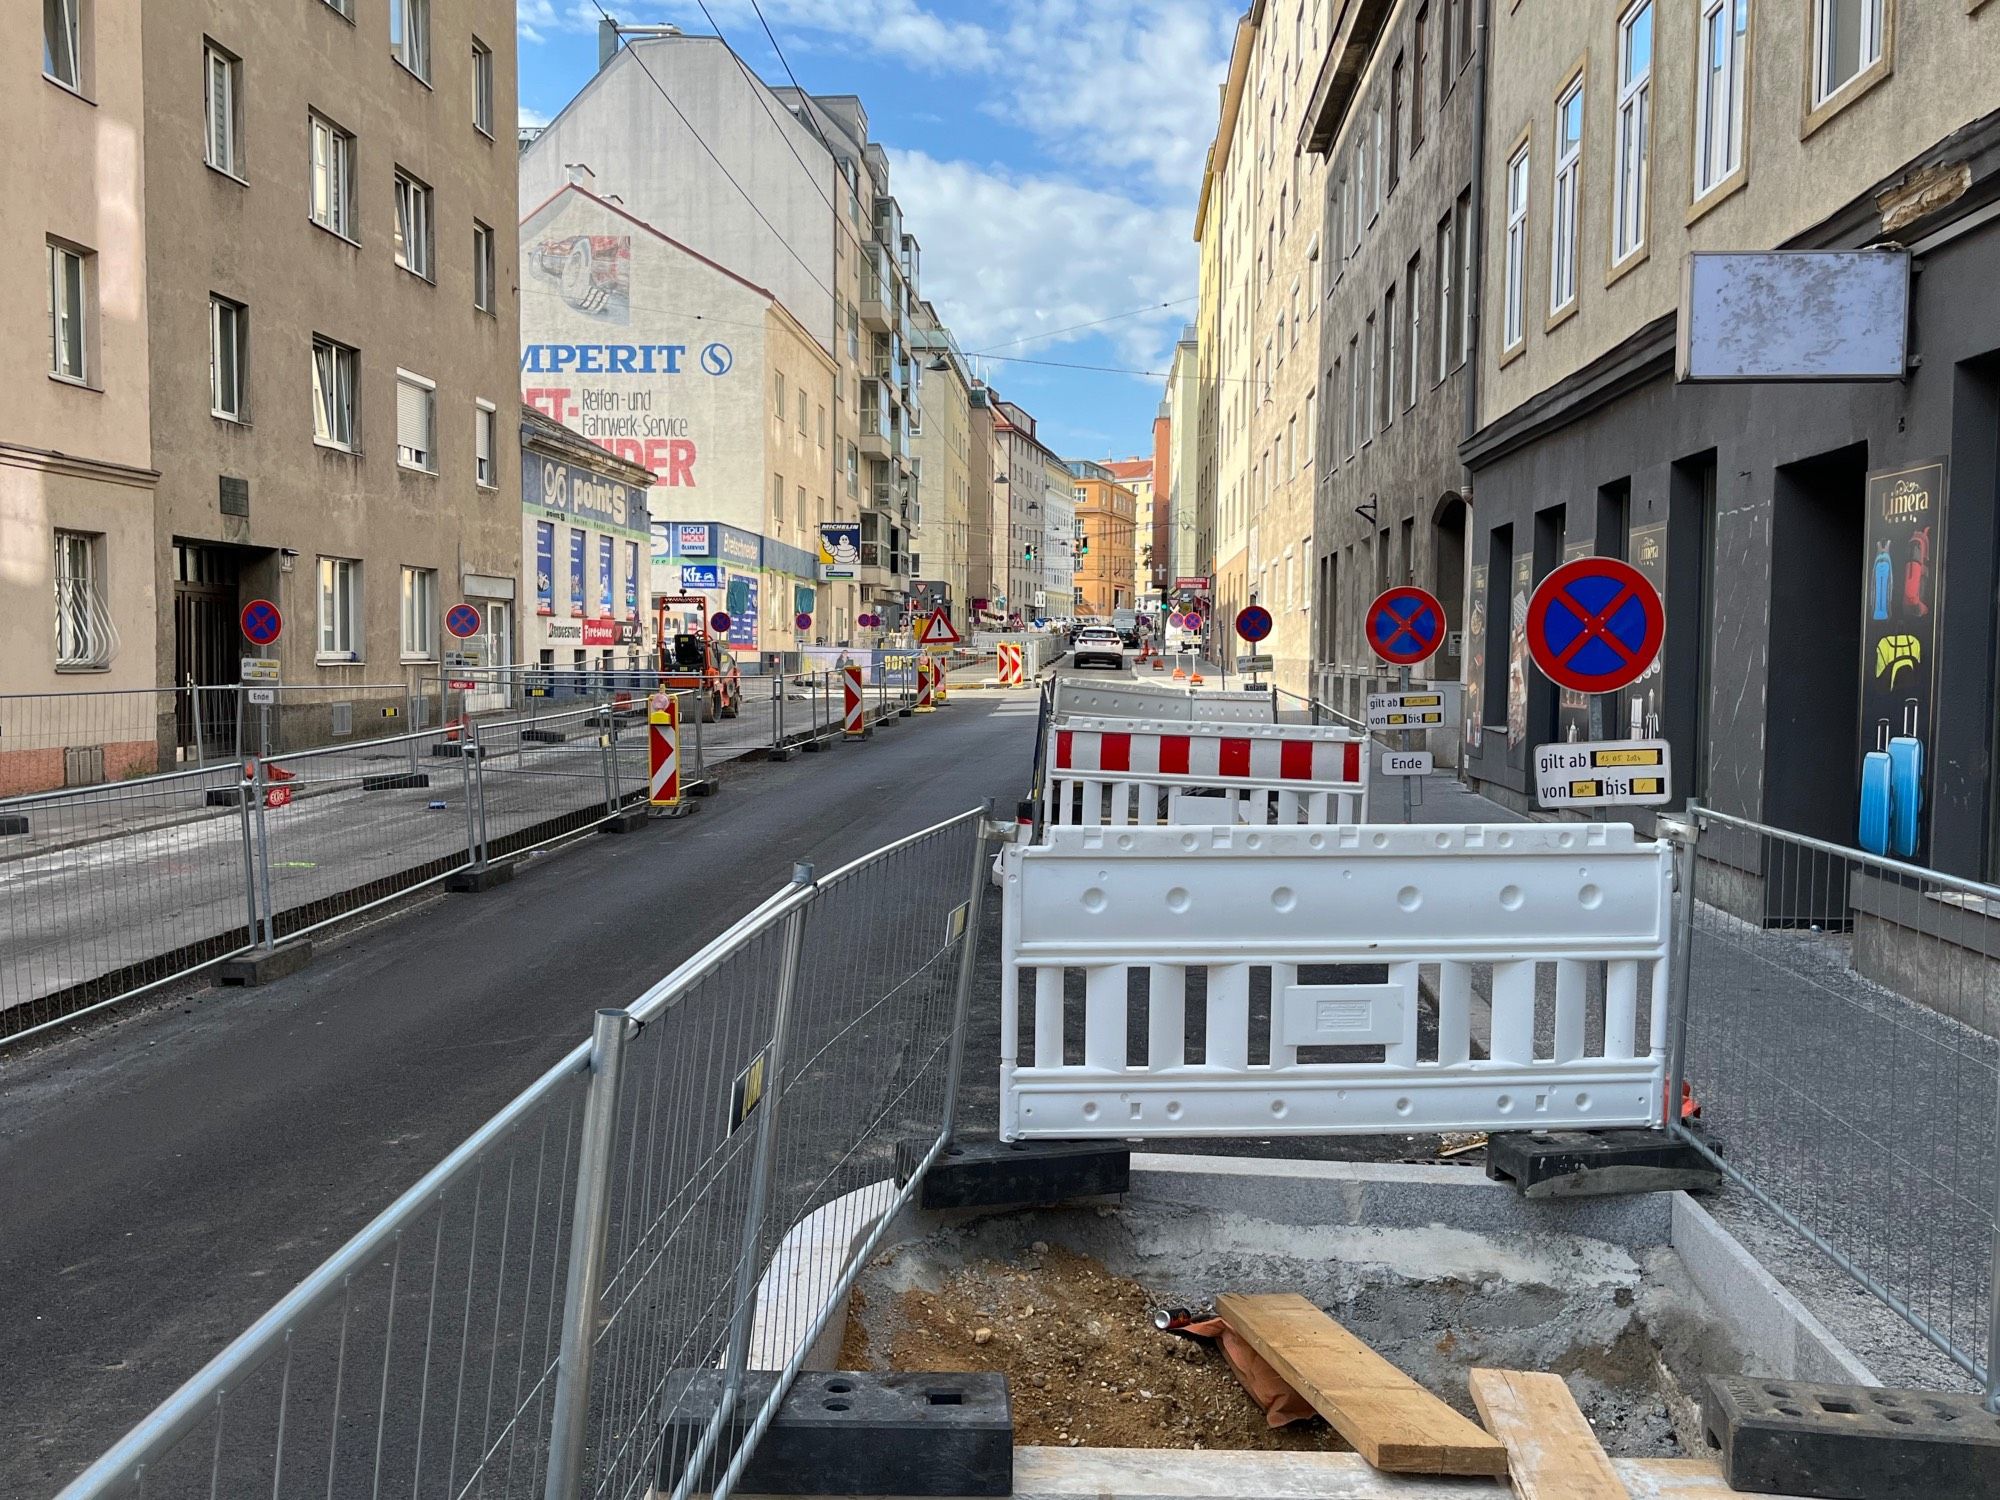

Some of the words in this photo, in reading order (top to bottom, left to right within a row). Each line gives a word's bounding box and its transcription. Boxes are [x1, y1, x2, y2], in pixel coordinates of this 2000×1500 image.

[1882, 491, 1929, 517] Limera
[682, 527, 705, 535] LIQUI
[585, 625, 612, 639] Firestone
[253, 693, 270, 701] Ende
[1370, 699, 1385, 709] gilt
[1387, 699, 1398, 707] ab
[1370, 717, 1386, 725] von
[1408, 713, 1421, 723] bis
[1391, 758, 1423, 769] Ende
[1541, 754, 1565, 773] gilt
[1569, 753, 1587, 768] ab
[1542, 786, 1566, 798] von
[1606, 780, 1627, 795] bis
